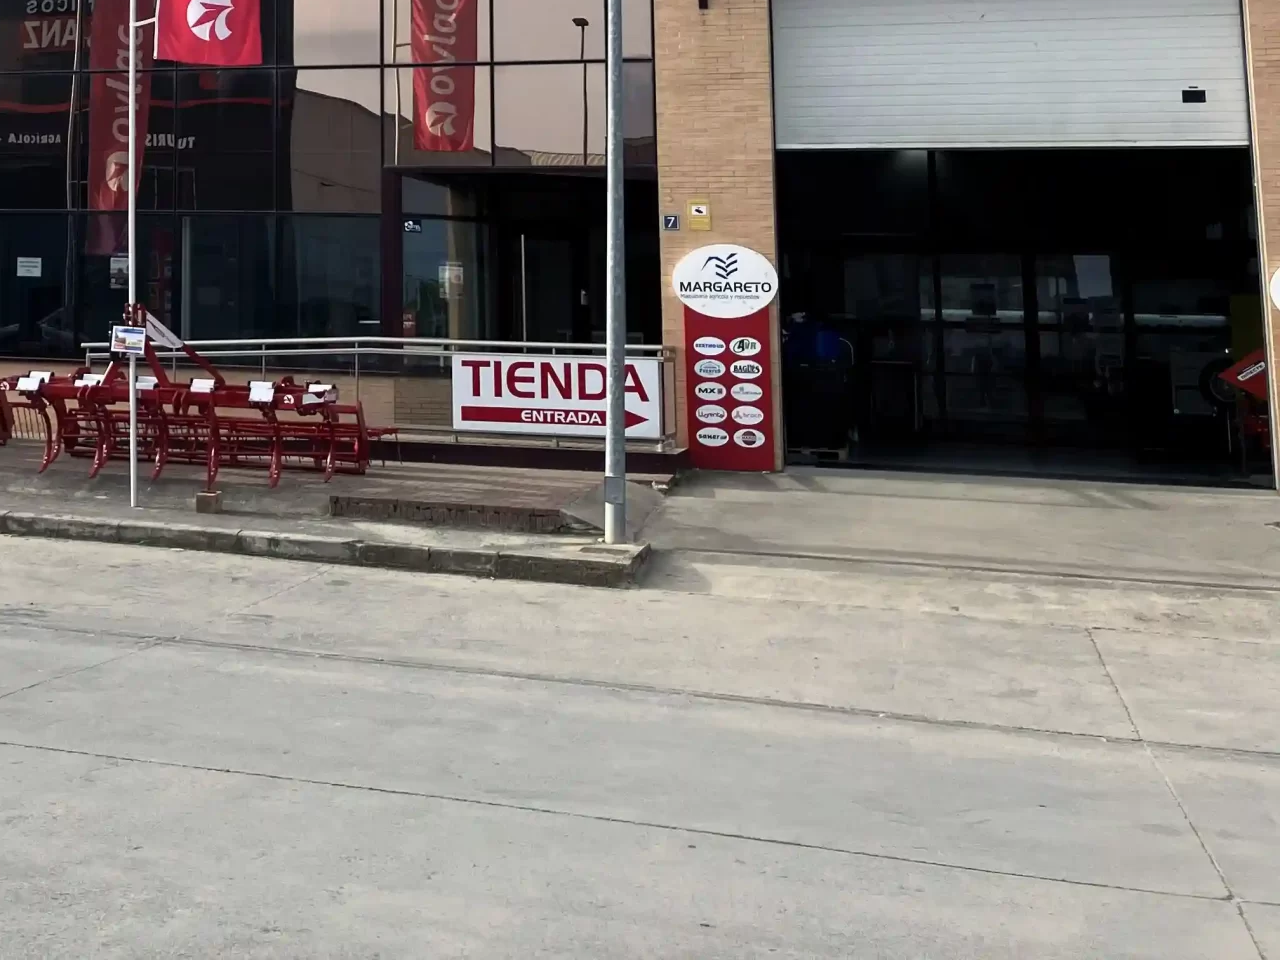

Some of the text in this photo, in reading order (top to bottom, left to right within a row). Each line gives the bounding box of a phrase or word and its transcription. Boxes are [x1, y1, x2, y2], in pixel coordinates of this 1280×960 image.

[666, 216, 675, 228] 7
[680, 282, 771, 293] MARGARETO
[461, 360, 650, 402] TIENDA
[521, 410, 602, 424] ENTRADA
